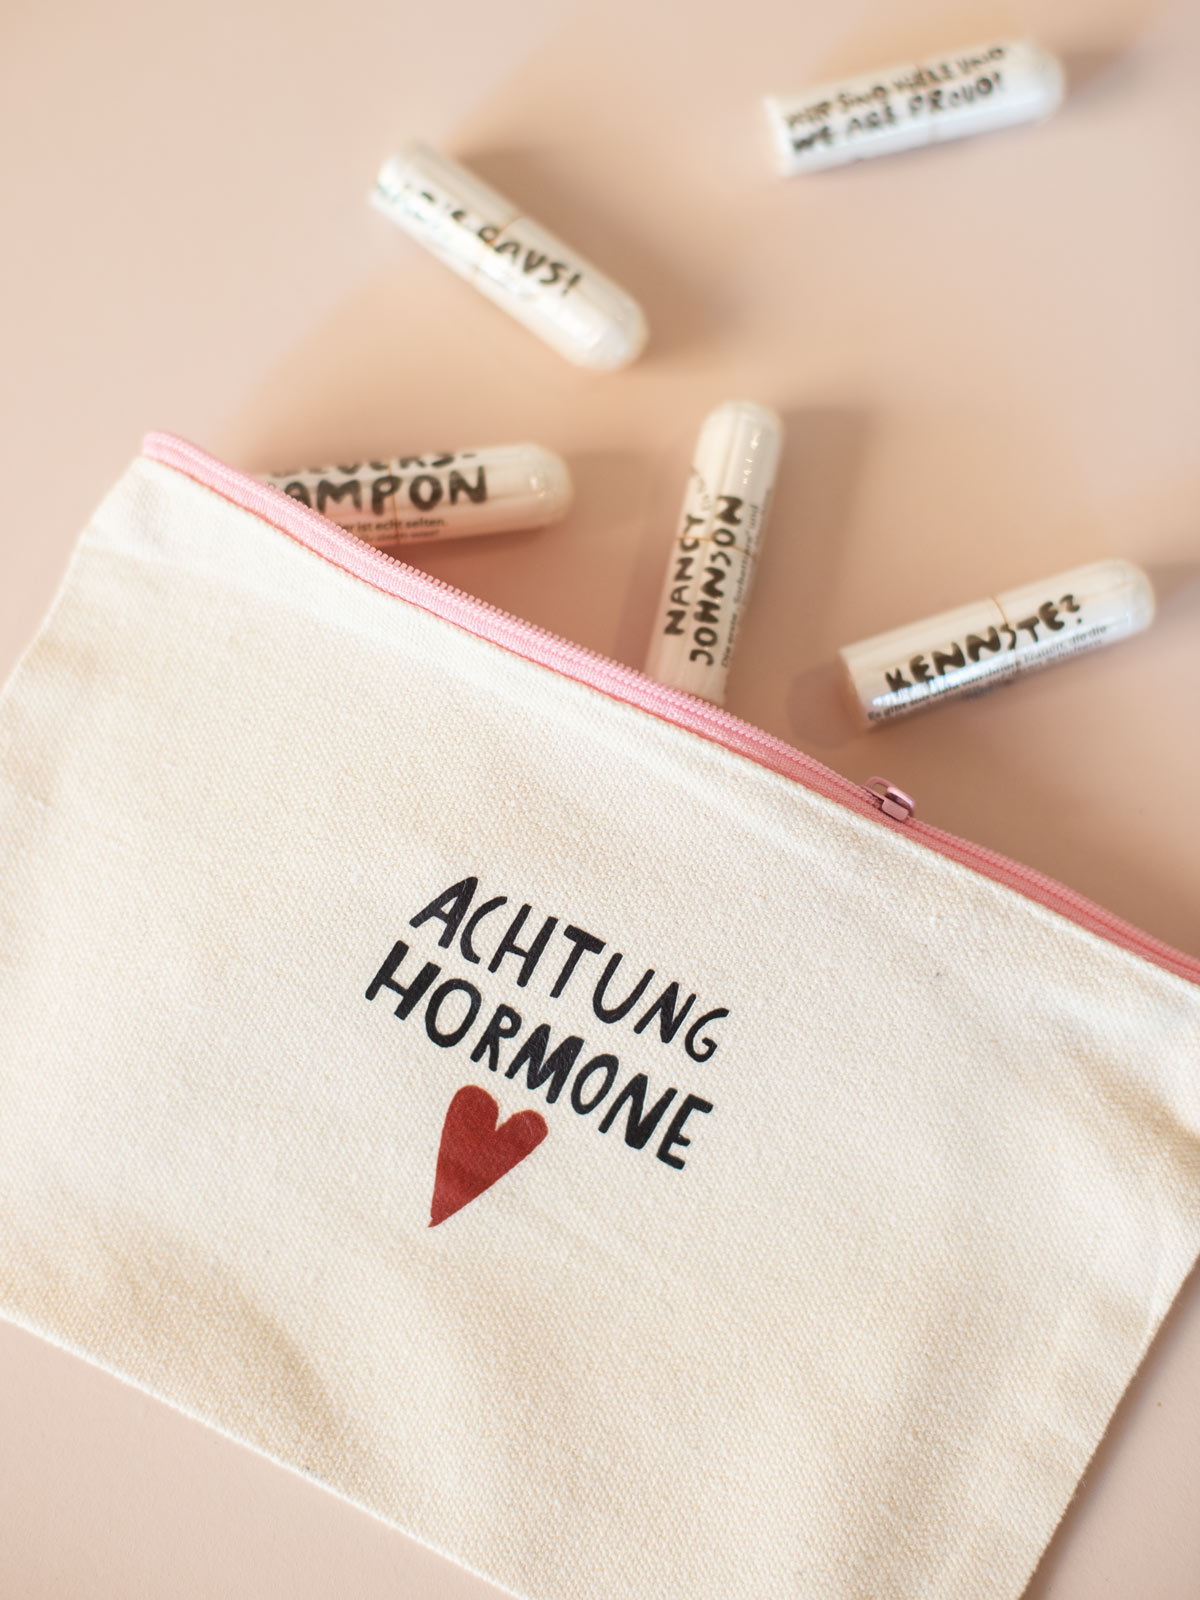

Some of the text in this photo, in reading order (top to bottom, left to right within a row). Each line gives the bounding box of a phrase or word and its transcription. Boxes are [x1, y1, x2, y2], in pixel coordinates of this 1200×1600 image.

[664, 513, 705, 636] NANCY
[689, 495, 744, 667] JOHNSON
[884, 593, 1081, 693] KENNSTE?
[365, 939, 714, 1171] HORMONE
[409, 876, 730, 1063] ACHTUNG
